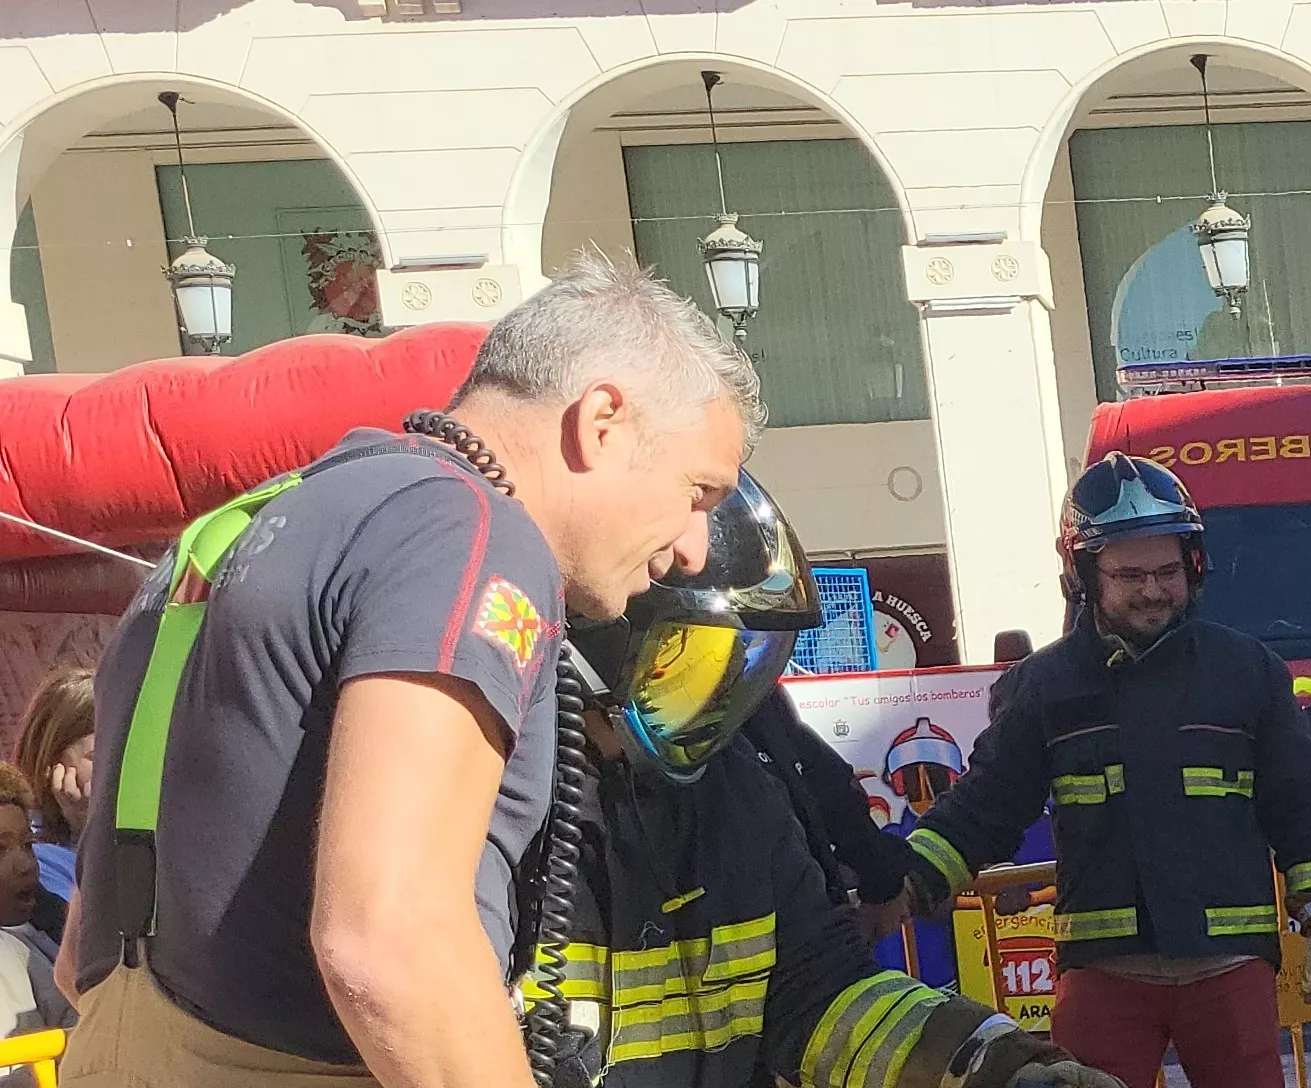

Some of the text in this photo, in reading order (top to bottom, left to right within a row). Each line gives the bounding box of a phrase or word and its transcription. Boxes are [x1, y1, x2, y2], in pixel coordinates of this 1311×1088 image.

[1120, 346, 1178, 361] Cultura
[885, 594, 933, 642] HUESCA
[799, 698, 841, 710] escolar
[873, 690, 911, 708] amigos
[913, 690, 929, 703] los
[973, 915, 1056, 940] eergenci
[1003, 958, 1053, 994] 112
[1020, 1004, 1051, 1020] ARA
